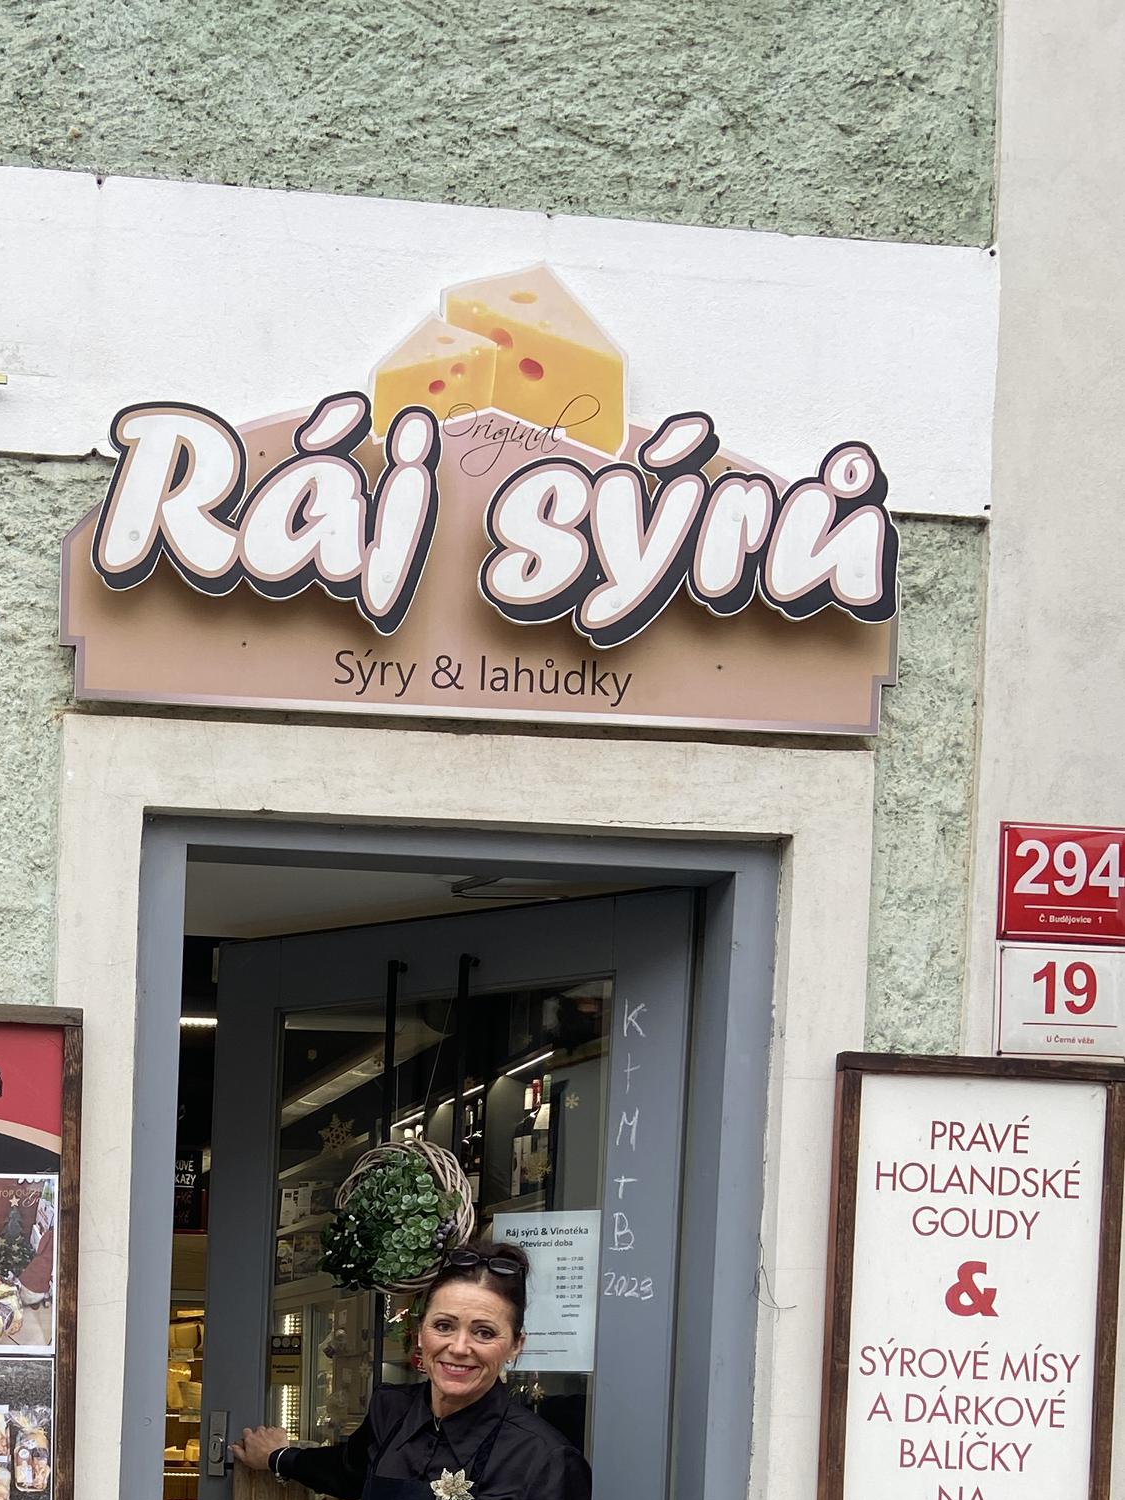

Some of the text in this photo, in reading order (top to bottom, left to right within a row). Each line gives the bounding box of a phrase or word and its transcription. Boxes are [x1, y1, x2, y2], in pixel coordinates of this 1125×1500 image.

[443, 394, 600, 477] Original
[92, 392, 899, 649] Ráj sýrů
[334, 649, 633, 707] Sýry & lahůdky
[1013, 839, 1125, 898] 294
[1049, 914, 1092, 925] Budějovice
[1033, 961, 1098, 1016] 19
[1054, 1033, 1075, 1044] Černé
[930, 1115, 1030, 1154] PRAVÉ
[875, 1160, 1081, 1199] HOLANDSKÉ
[540, 1227, 548, 1236] &
[550, 1226, 589, 1236] Vinotéka
[554, 1239, 573, 1247] doba
[912, 1206, 1040, 1240] GOUDY
[603, 1270, 655, 1300] 2023
[945, 1261, 999, 1317] &
[858, 1338, 1081, 1384] SÝROVÉ MÍSY
[867, 1386, 1066, 1429] A DÁRKOVÉ
[899, 1431, 1032, 1472] BALÍČKY
